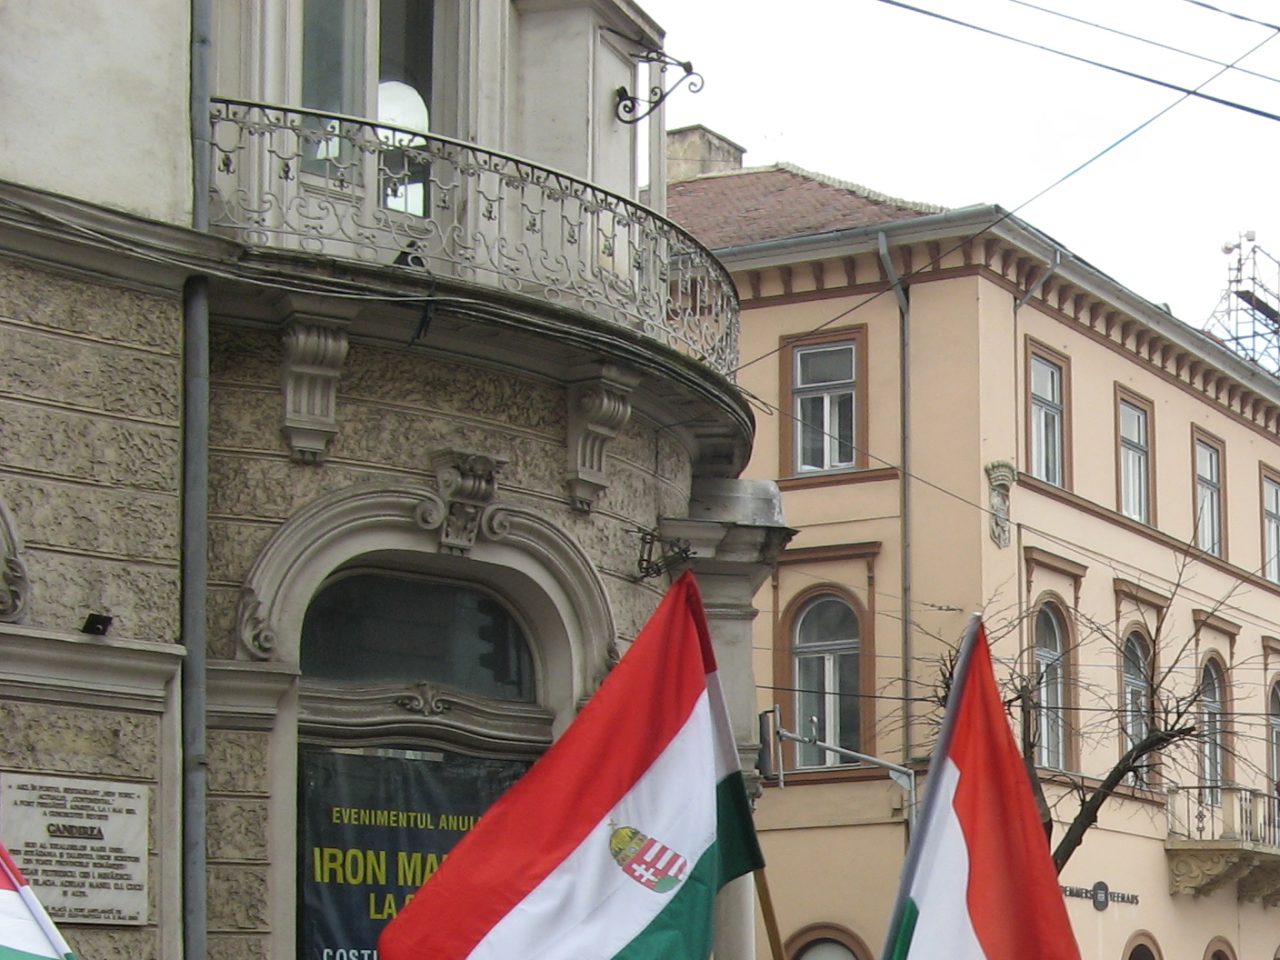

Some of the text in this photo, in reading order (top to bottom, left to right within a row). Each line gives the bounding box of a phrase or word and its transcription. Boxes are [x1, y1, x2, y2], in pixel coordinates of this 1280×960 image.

[332, 807, 483, 832] EVENIMENTUL ANUL
[313, 847, 449, 888] IRON MA
[369, 892, 398, 920] LA
